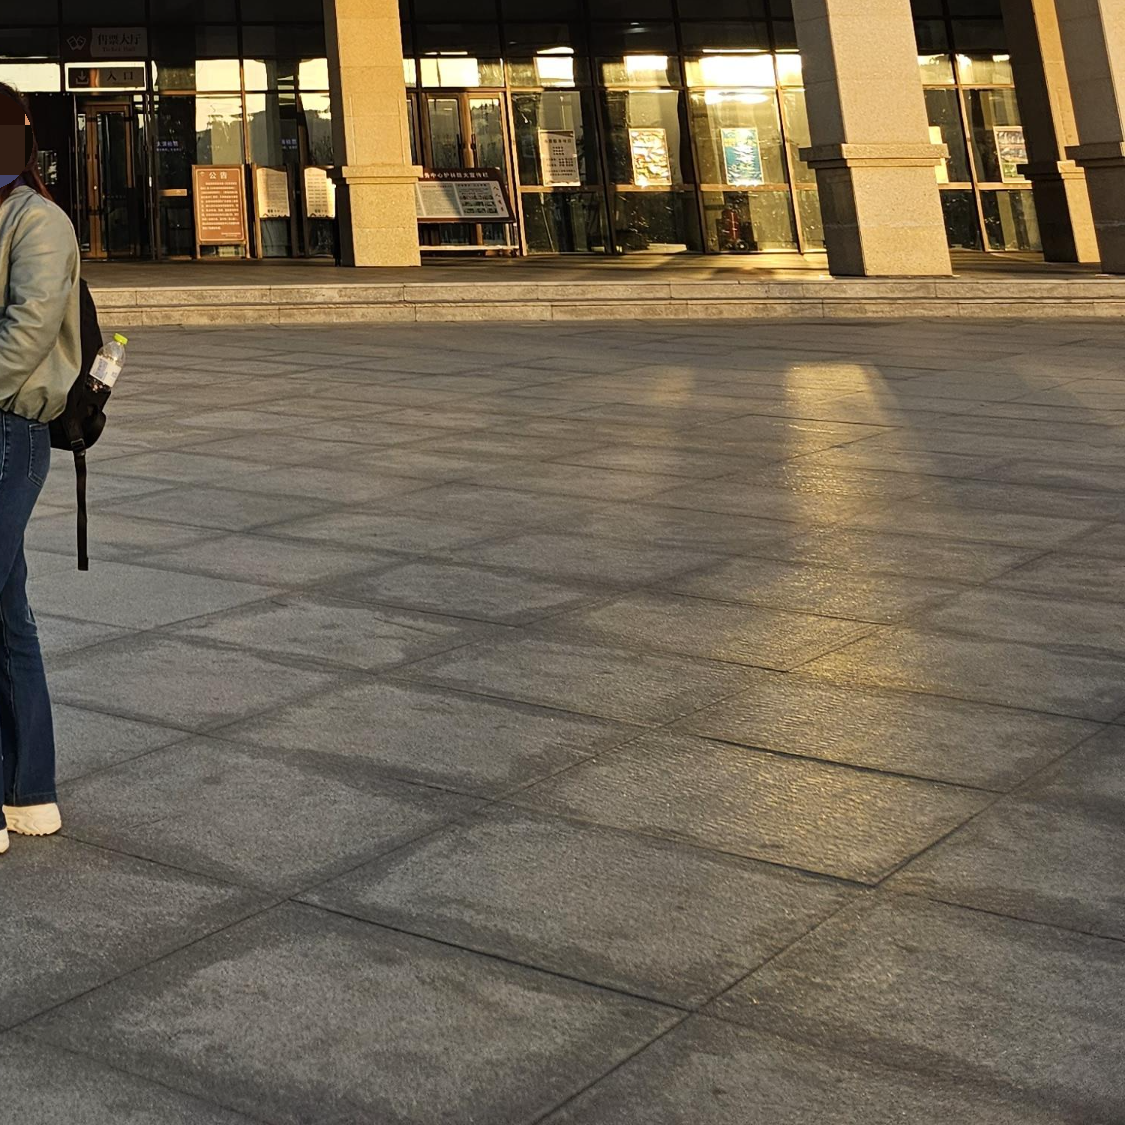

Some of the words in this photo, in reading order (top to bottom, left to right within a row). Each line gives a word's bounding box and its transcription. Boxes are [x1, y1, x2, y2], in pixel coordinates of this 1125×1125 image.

[98, 33, 142, 46] 售票大厅
[106, 71, 134, 81] 入口
[209, 171, 227, 180] 公告
